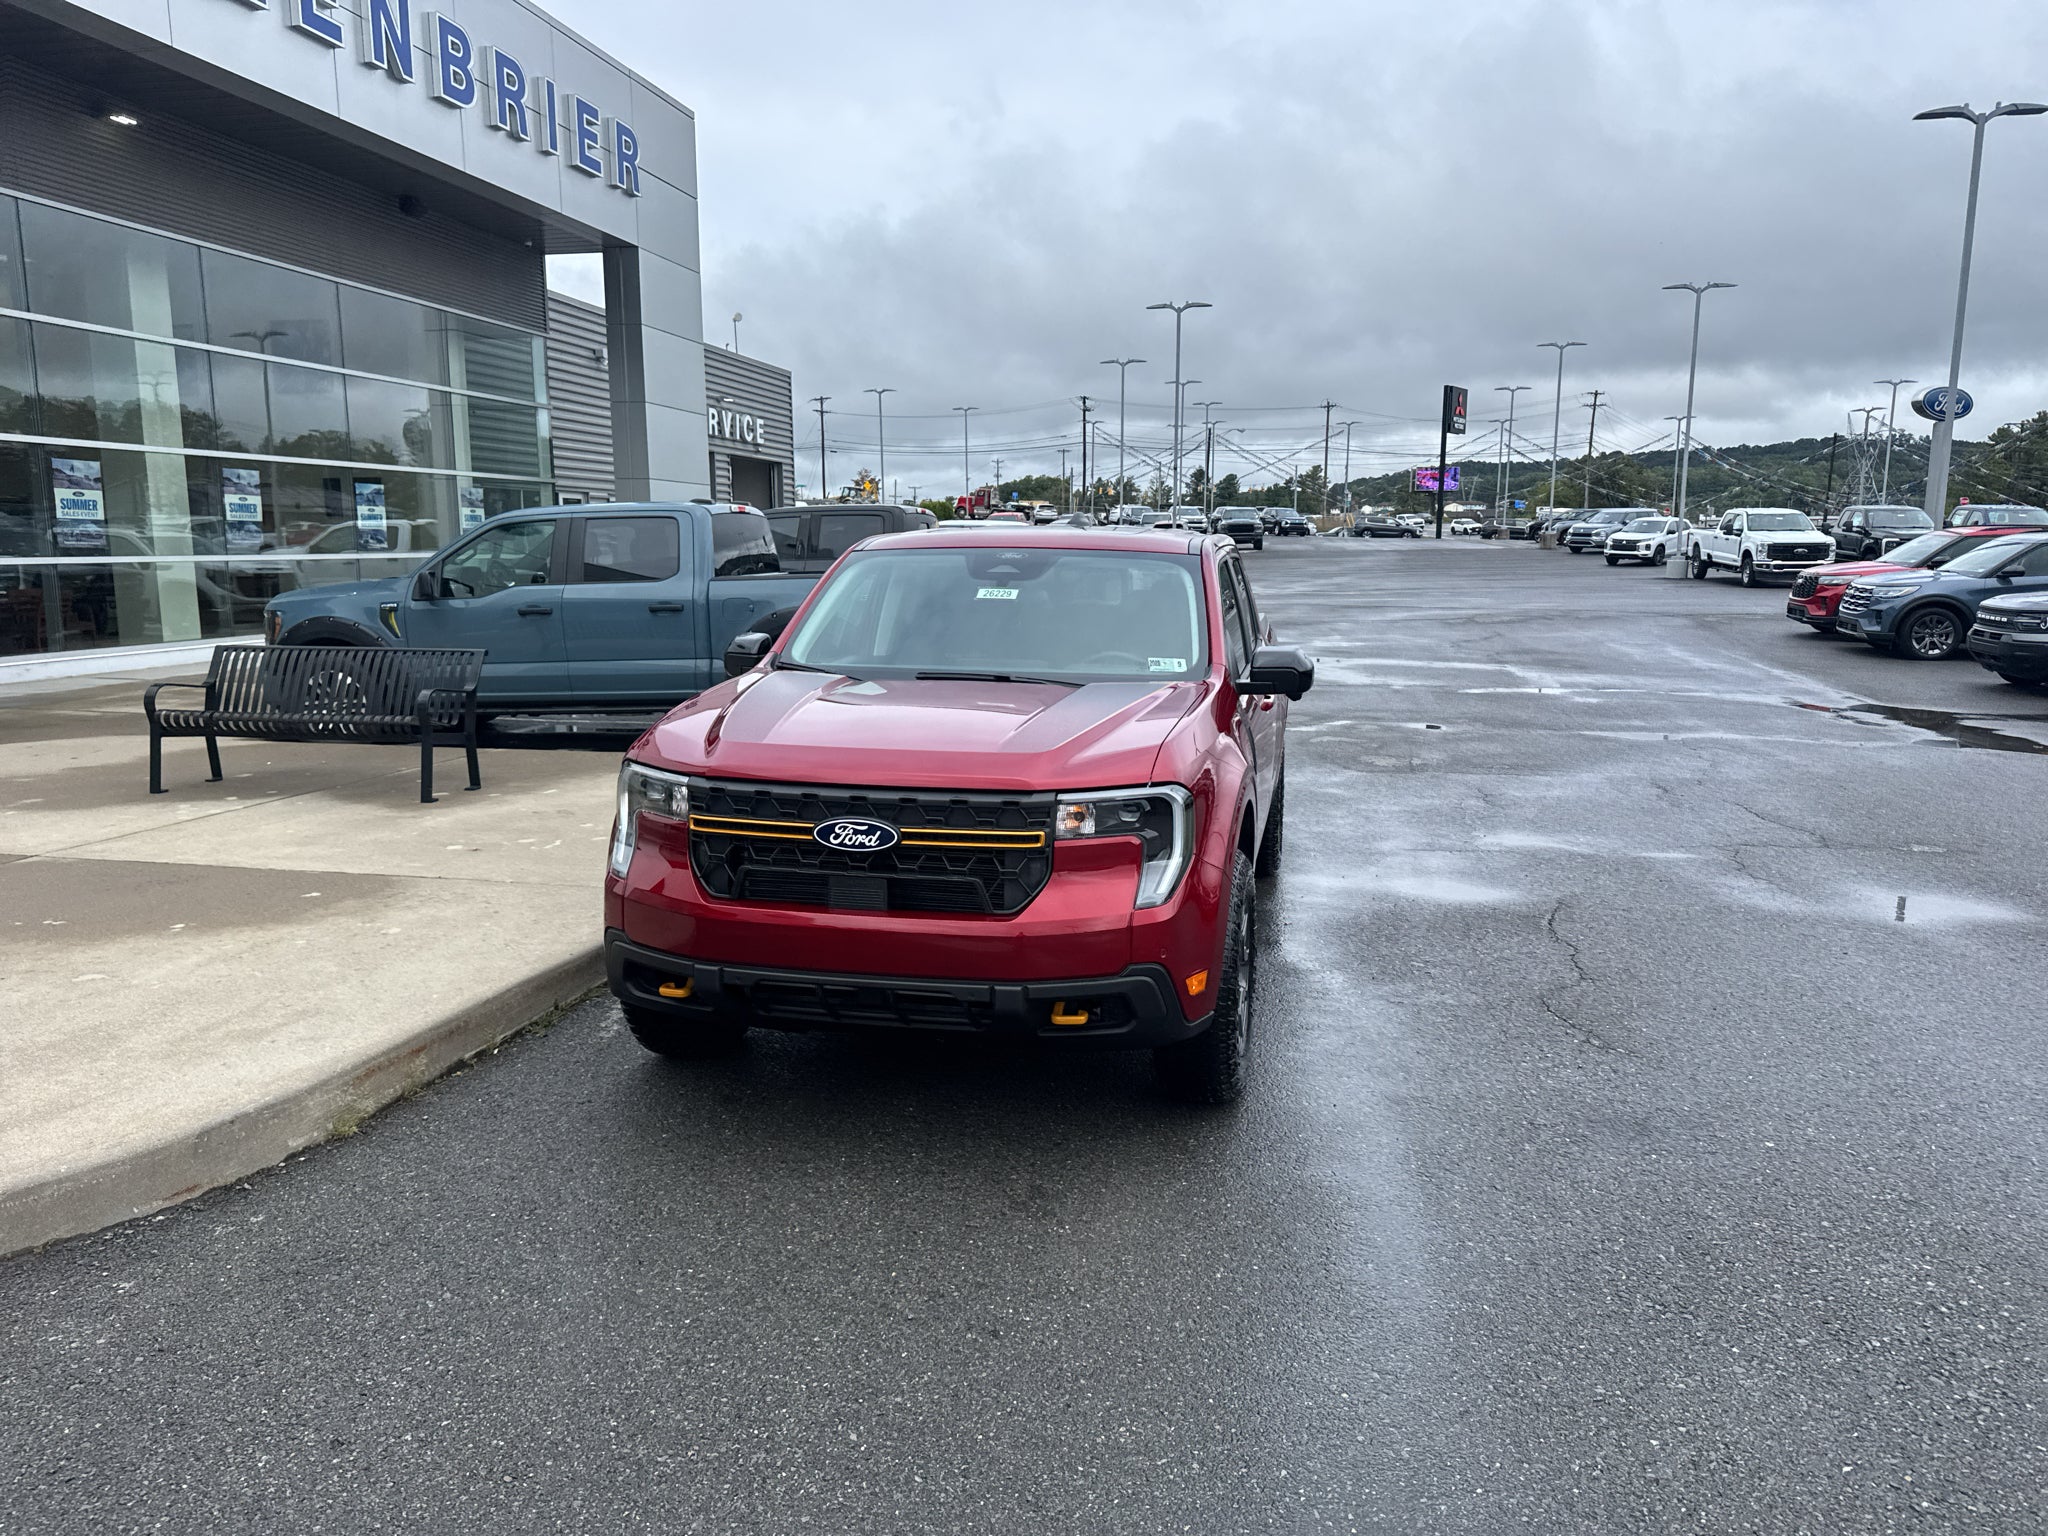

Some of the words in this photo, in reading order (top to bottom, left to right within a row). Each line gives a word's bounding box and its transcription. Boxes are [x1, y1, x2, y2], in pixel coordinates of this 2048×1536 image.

[246, 0, 641, 196] NBRIER
[1934, 392, 1965, 413] Fd
[708, 407, 765, 444] RVICE
[60, 498, 98, 511] SUMMER
[229, 503, 258, 513] SUMMER
[983, 589, 1012, 597] 26229
[1977, 613, 2008, 622] BRONCO
[829, 823, 881, 847] Ford
